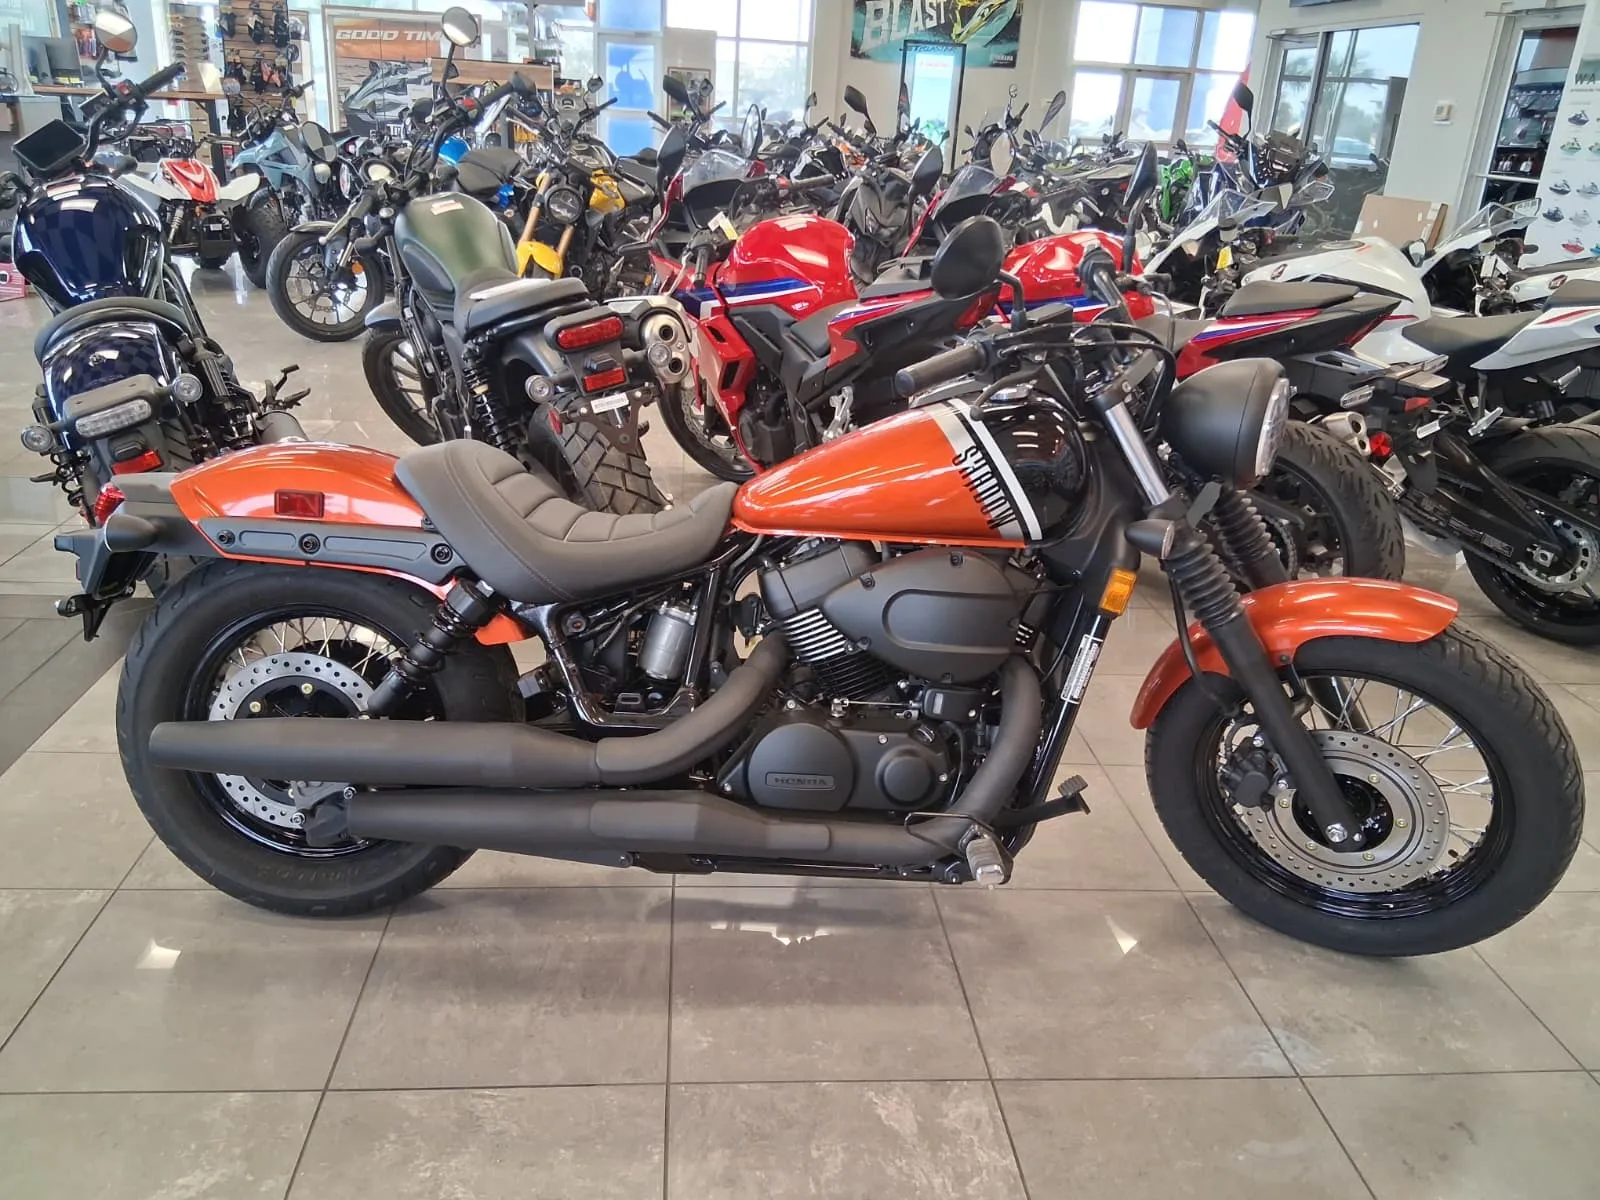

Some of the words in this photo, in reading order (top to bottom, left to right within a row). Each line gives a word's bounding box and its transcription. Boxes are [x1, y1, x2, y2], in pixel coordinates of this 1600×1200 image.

[335, 29, 399, 40] GOOD
[403, 31, 442, 41] TIM
[860, 0, 946, 53] BLAST
[952, 445, 1018, 530] SHADOW
[774, 777, 828, 786] HONDA
